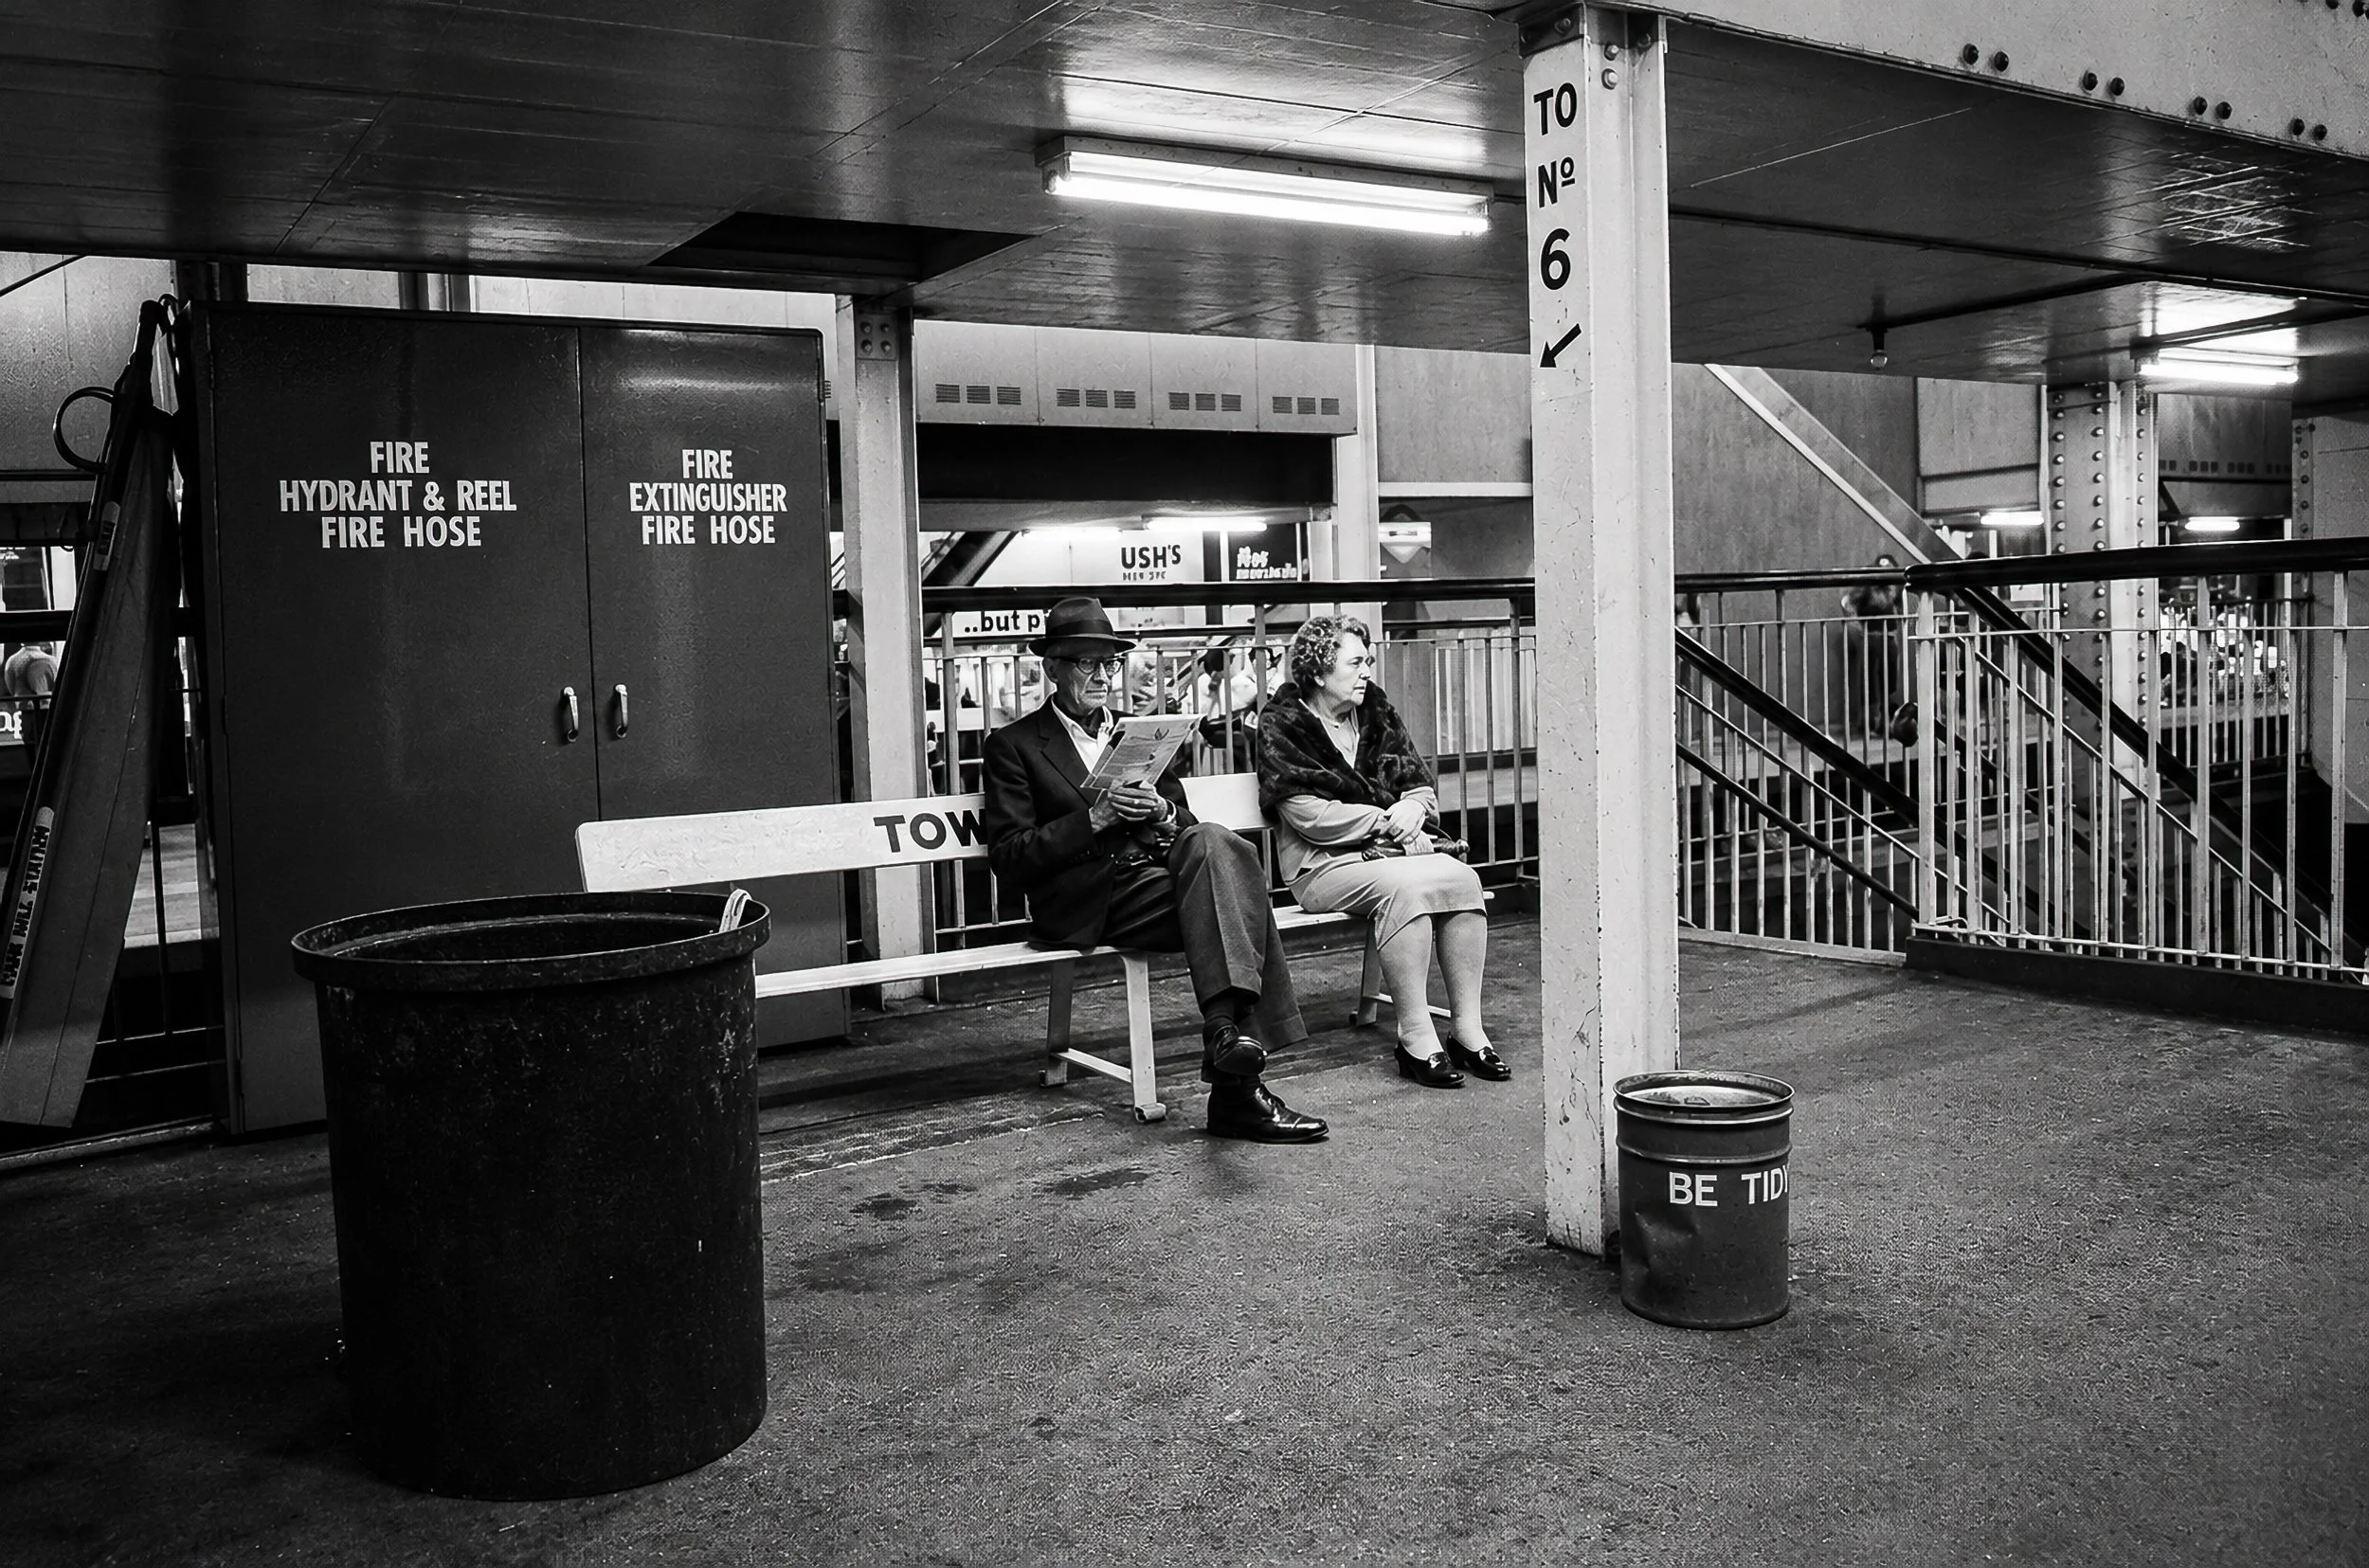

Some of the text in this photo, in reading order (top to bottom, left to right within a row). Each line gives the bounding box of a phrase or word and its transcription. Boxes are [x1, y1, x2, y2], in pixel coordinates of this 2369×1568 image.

[1533, 82, 1577, 135] TO
[1541, 228, 1570, 290] 6
[371, 442, 429, 473] FIRE
[682, 449, 732, 478] FIRE
[280, 480, 516, 512] HYDRANT & REEL
[629, 483, 787, 512] EXTINGUISHER
[322, 516, 481, 548] FIRE HOSE
[642, 515, 775, 544] FIRE HOSE
[1121, 544, 1181, 569] USH'S
[1670, 1172, 1718, 1206] BE
